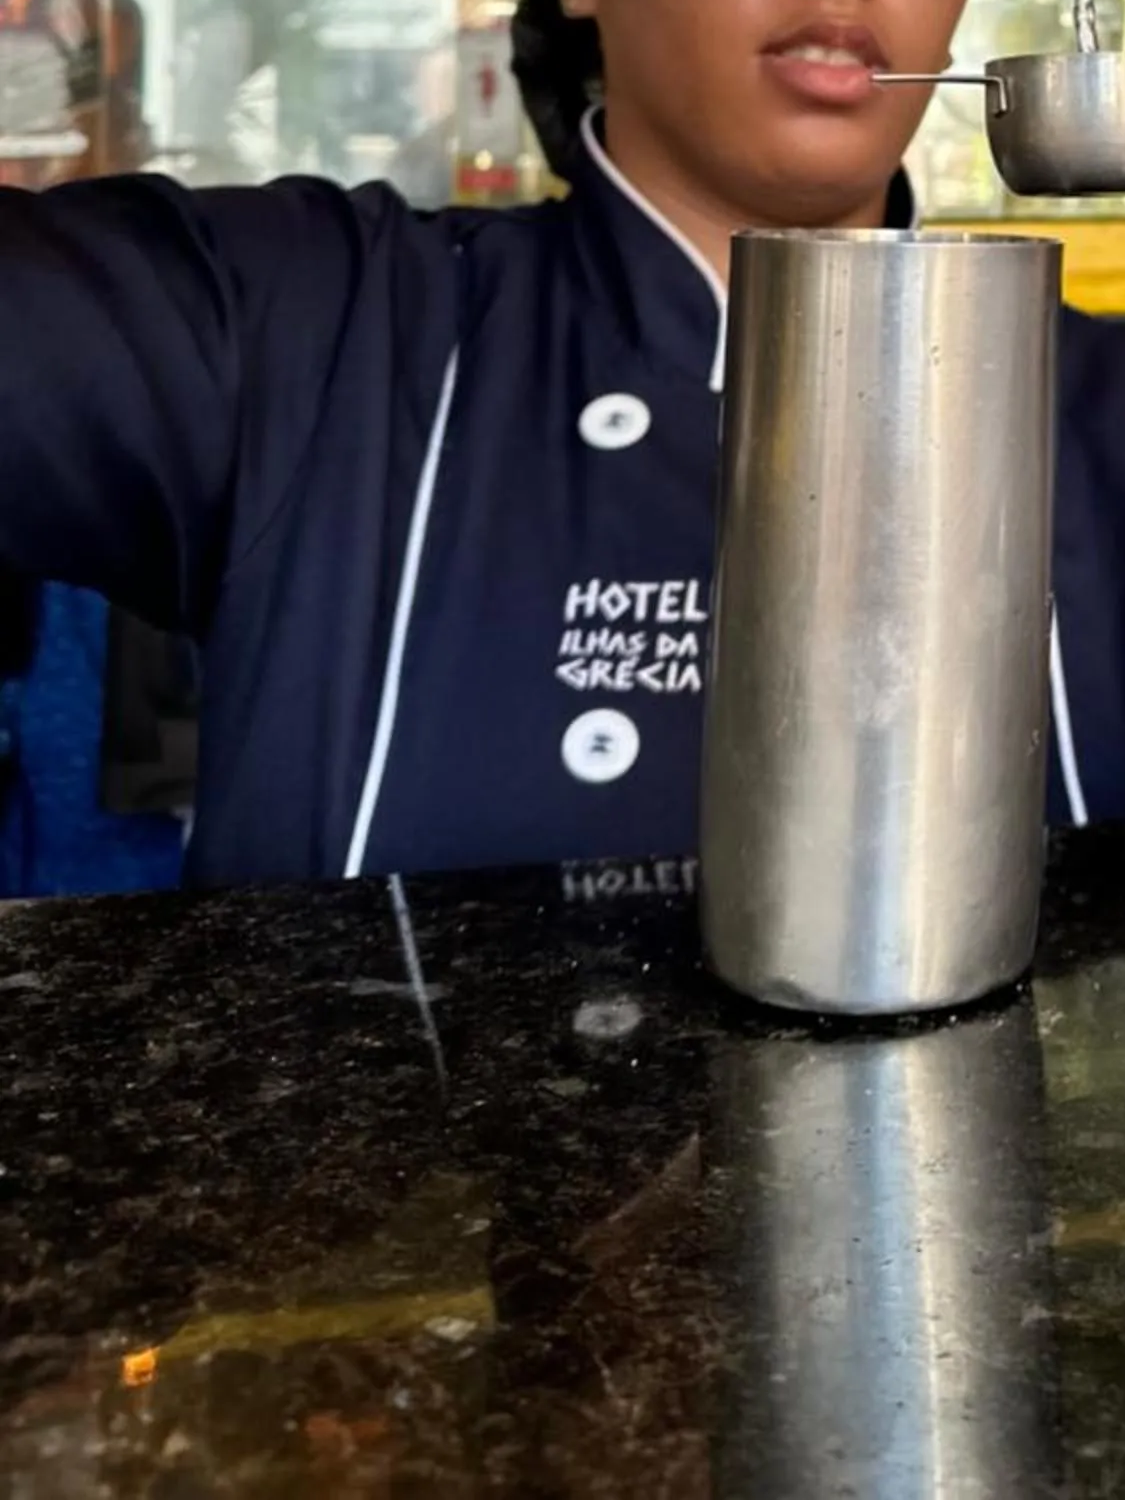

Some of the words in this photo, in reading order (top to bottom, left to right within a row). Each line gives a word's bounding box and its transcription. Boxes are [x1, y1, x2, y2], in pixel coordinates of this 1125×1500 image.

[564, 577, 709, 623] HOTEL
[558, 627, 649, 658] ILHAS
[654, 630, 699, 659] DA
